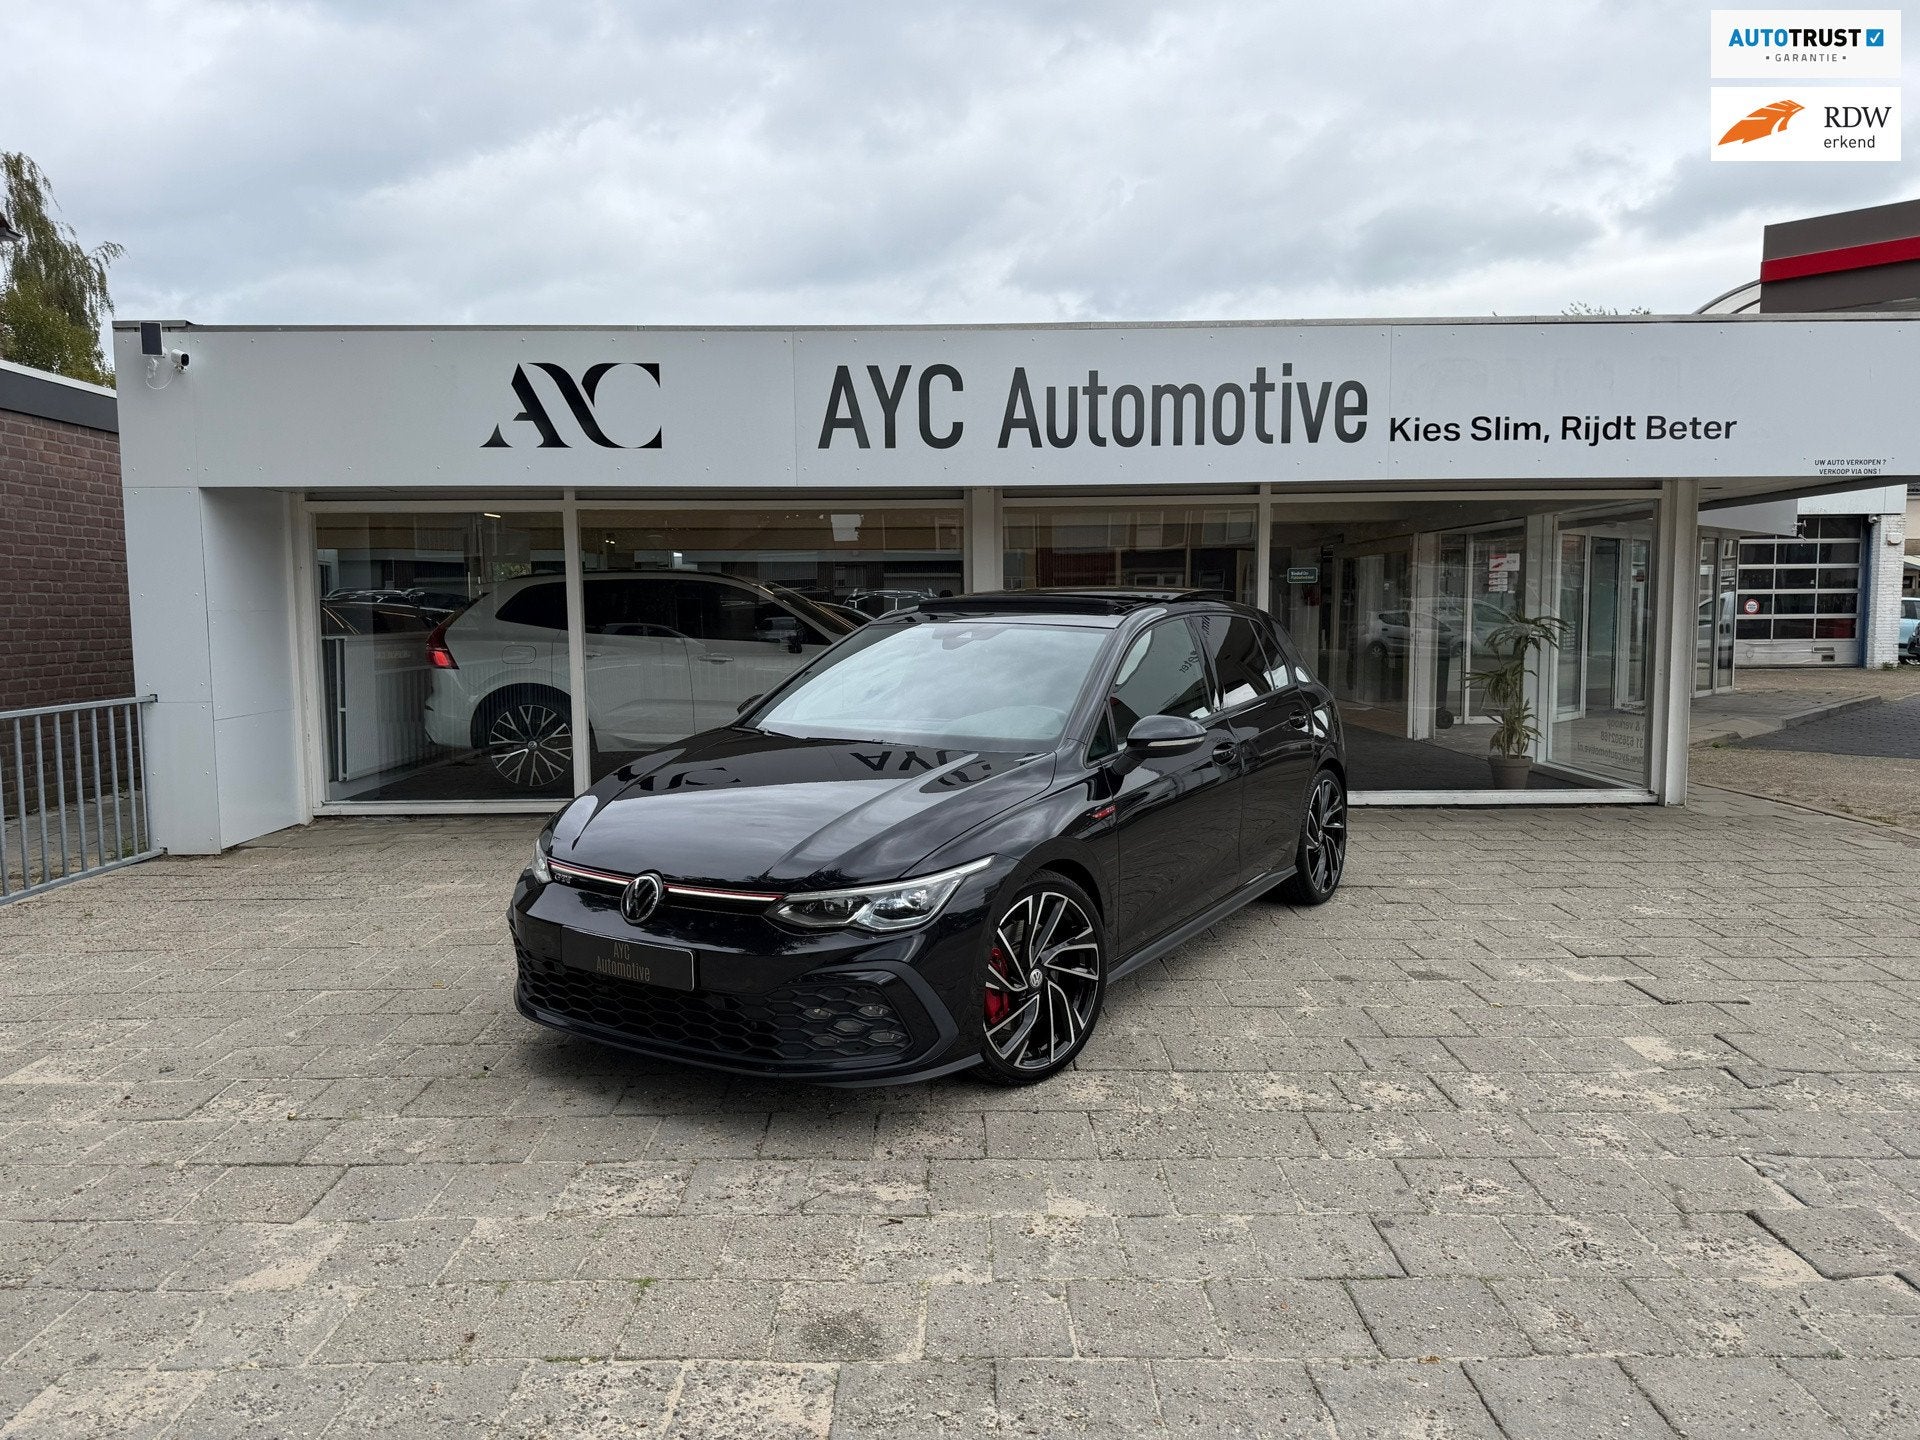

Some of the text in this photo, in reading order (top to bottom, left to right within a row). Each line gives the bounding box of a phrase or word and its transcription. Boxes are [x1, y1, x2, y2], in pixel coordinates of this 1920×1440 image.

[818, 362, 1369, 449] AYC Automotive
[1389, 415, 1738, 447] Kies Slim, Rijdt Beter
[613, 941, 630, 960] AYC
[596, 956, 650, 981] Automotive
